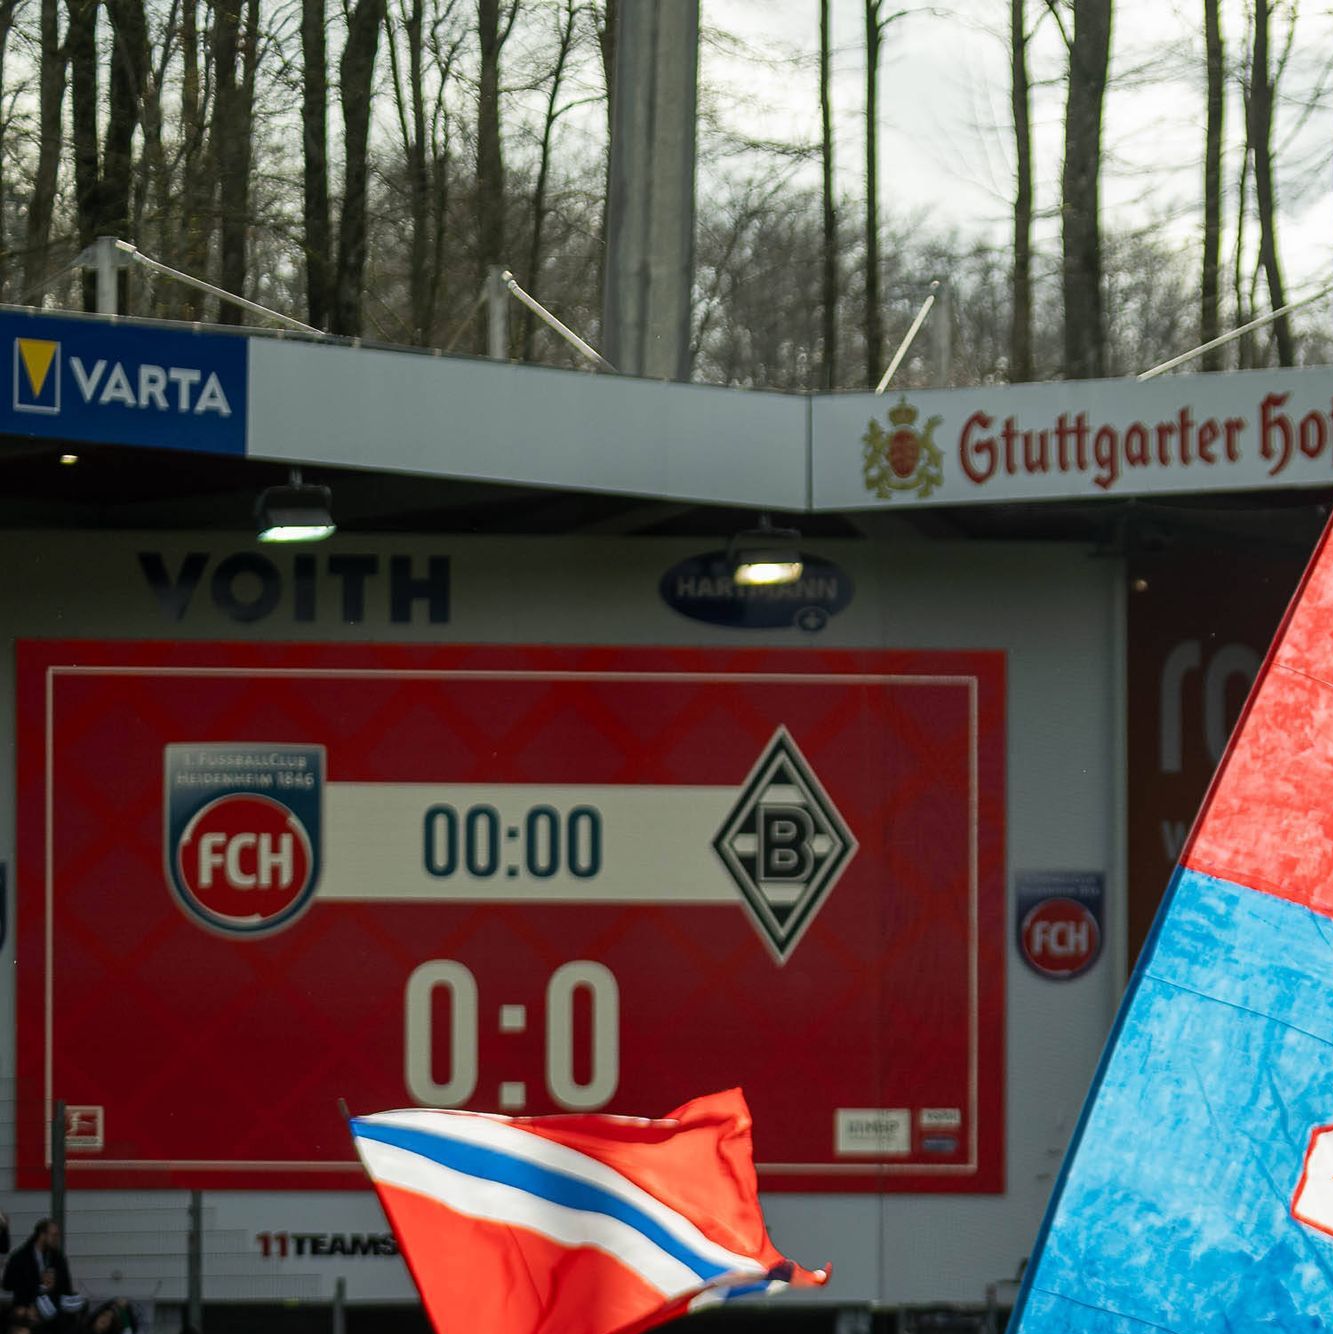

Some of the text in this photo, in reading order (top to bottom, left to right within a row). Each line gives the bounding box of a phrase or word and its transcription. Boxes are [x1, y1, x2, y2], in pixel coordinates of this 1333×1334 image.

[69, 356, 232, 417] VARTA
[957, 405, 1246, 490] Stuttgarter
[137, 551, 451, 625] VOITH
[199, 831, 294, 889] FCH
[423, 803, 602, 878] 00:00
[1033, 921, 1089, 954] FCH
[405, 959, 620, 1111] 0:0
